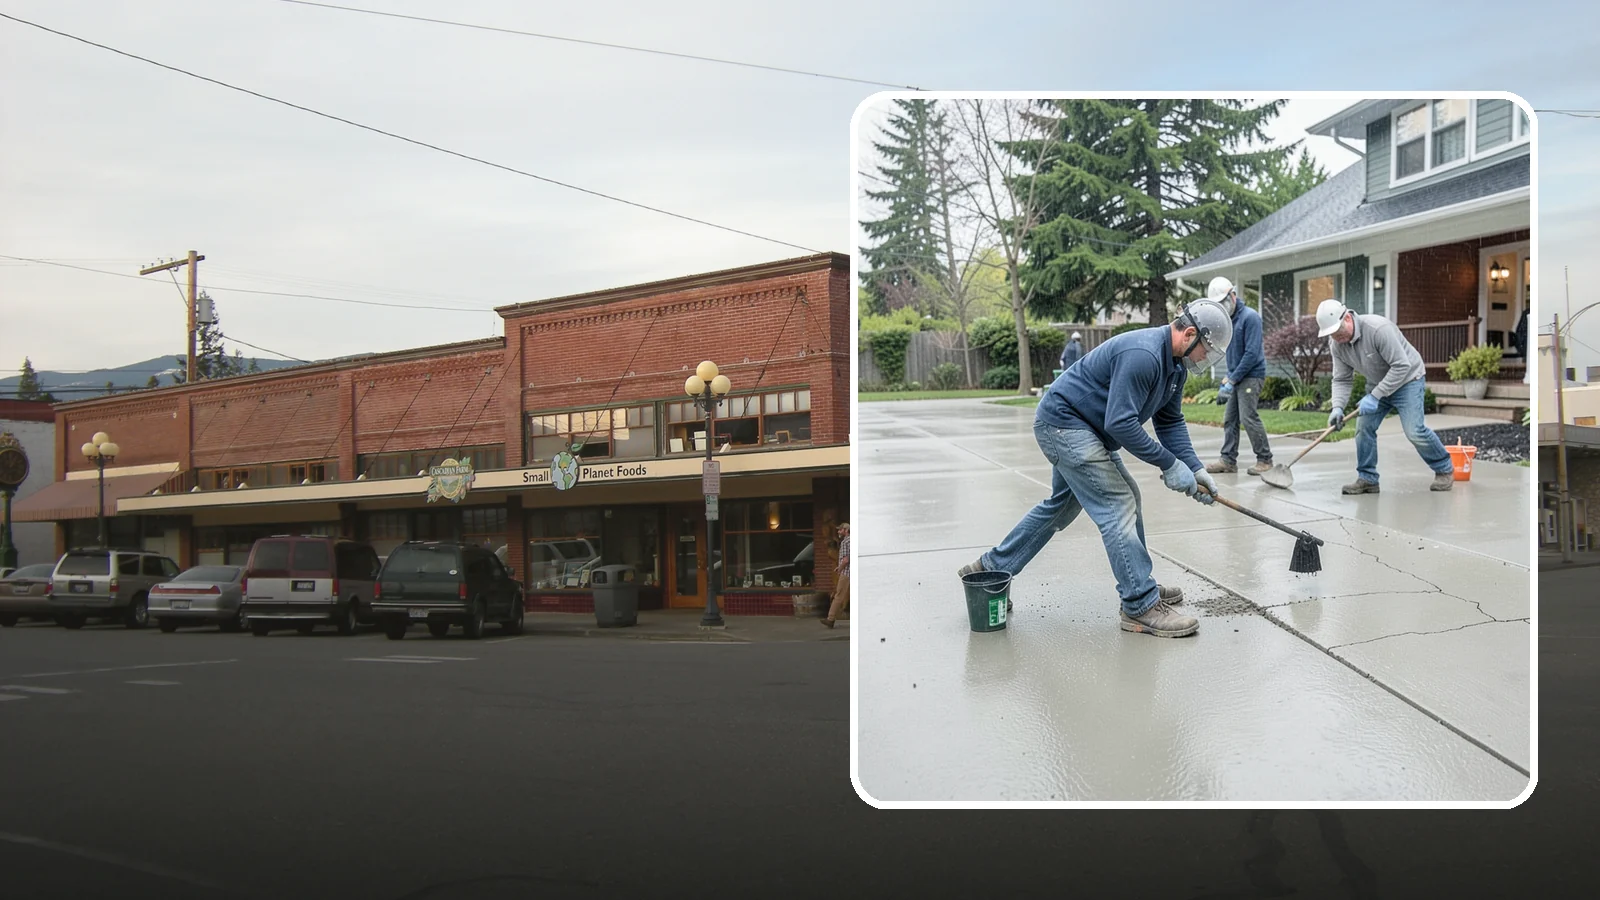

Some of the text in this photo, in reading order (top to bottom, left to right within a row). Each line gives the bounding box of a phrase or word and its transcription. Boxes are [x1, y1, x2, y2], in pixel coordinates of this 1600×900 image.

[523, 464, 647, 483] Small Planet Foods
